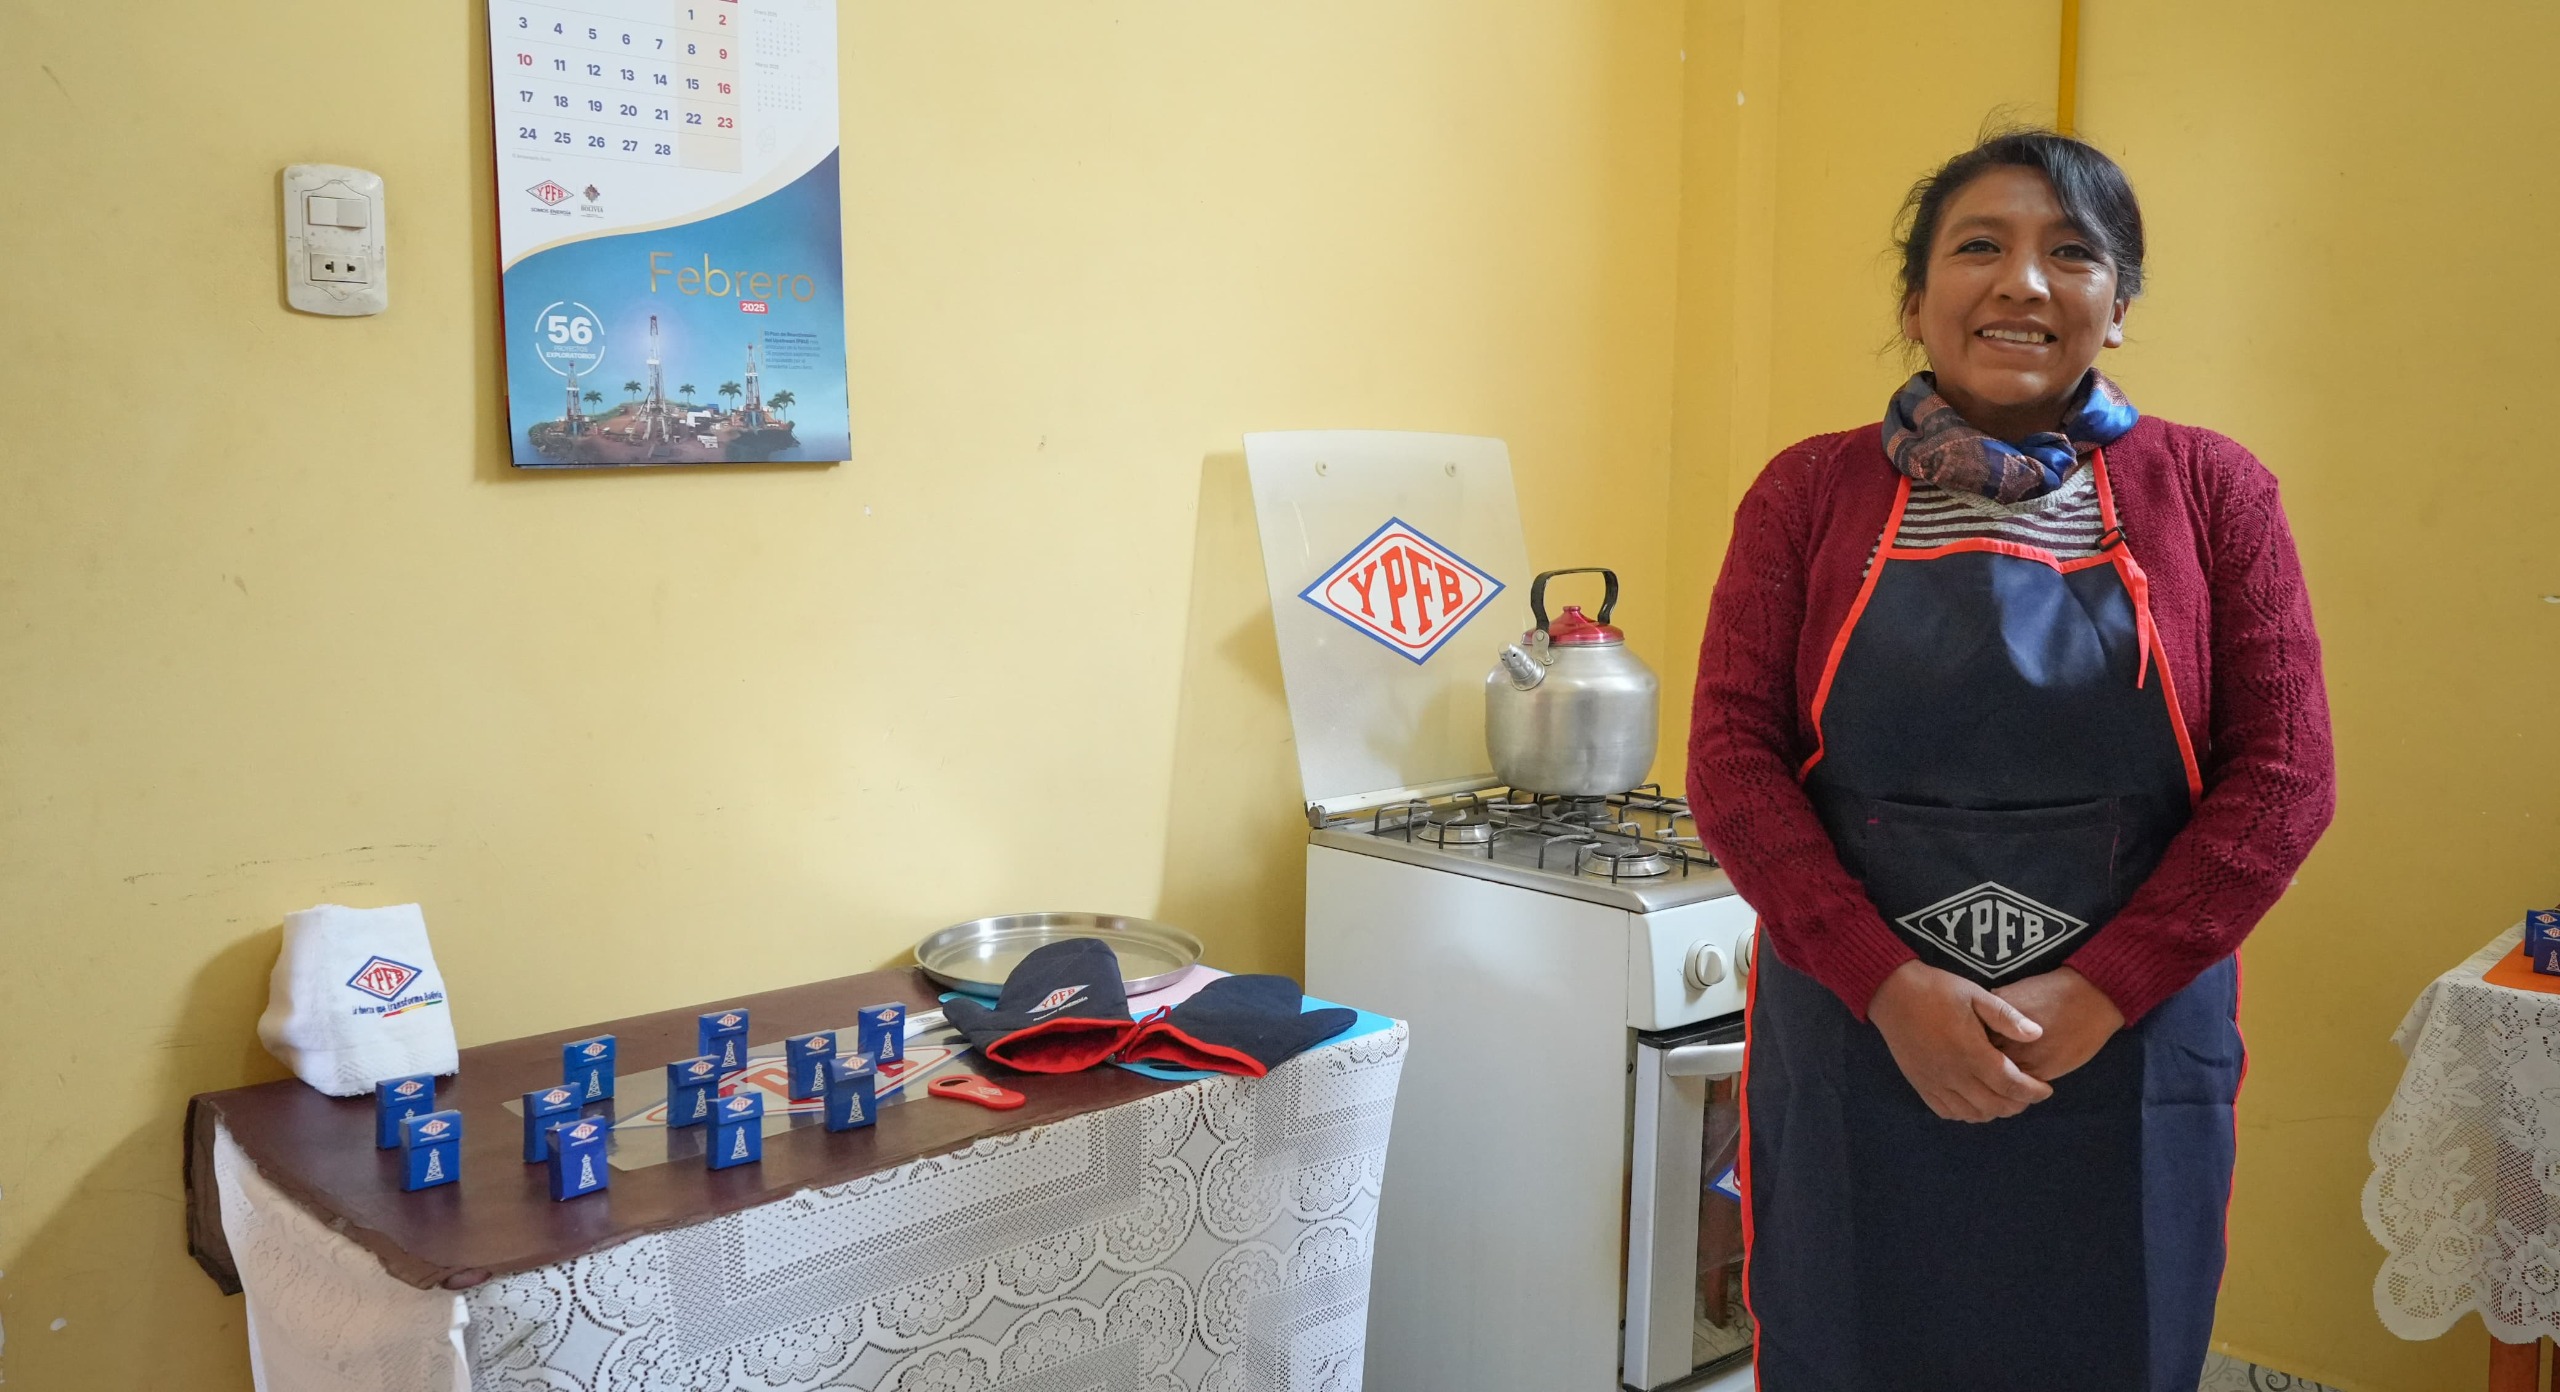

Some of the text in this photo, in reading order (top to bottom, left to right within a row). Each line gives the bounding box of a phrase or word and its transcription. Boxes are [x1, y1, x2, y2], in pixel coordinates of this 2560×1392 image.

[687, 9, 727, 26] 1 2
[518, 16, 728, 60] 3 4 5 6 7 8 9
[517, 53, 731, 95] 10 11 12 13 14 15 16
[519, 90, 734, 129] 17 18 19 20 21 22 23
[519, 126, 671, 156] 24 25 26 27 28
[537, 185, 564, 201] YPFB
[650, 251, 815, 302] Febrero
[742, 303, 765, 312] 2025
[547, 315, 593, 345] 56
[546, 351, 596, 360] EXPLORATORIOS
[1348, 545, 1464, 637] YPFB
[1937, 899, 2045, 961] YPFB
[363, 967, 405, 992] YPFB
[387, 995, 424, 1011] transforma
[1041, 988, 1076, 1009] YPFB
